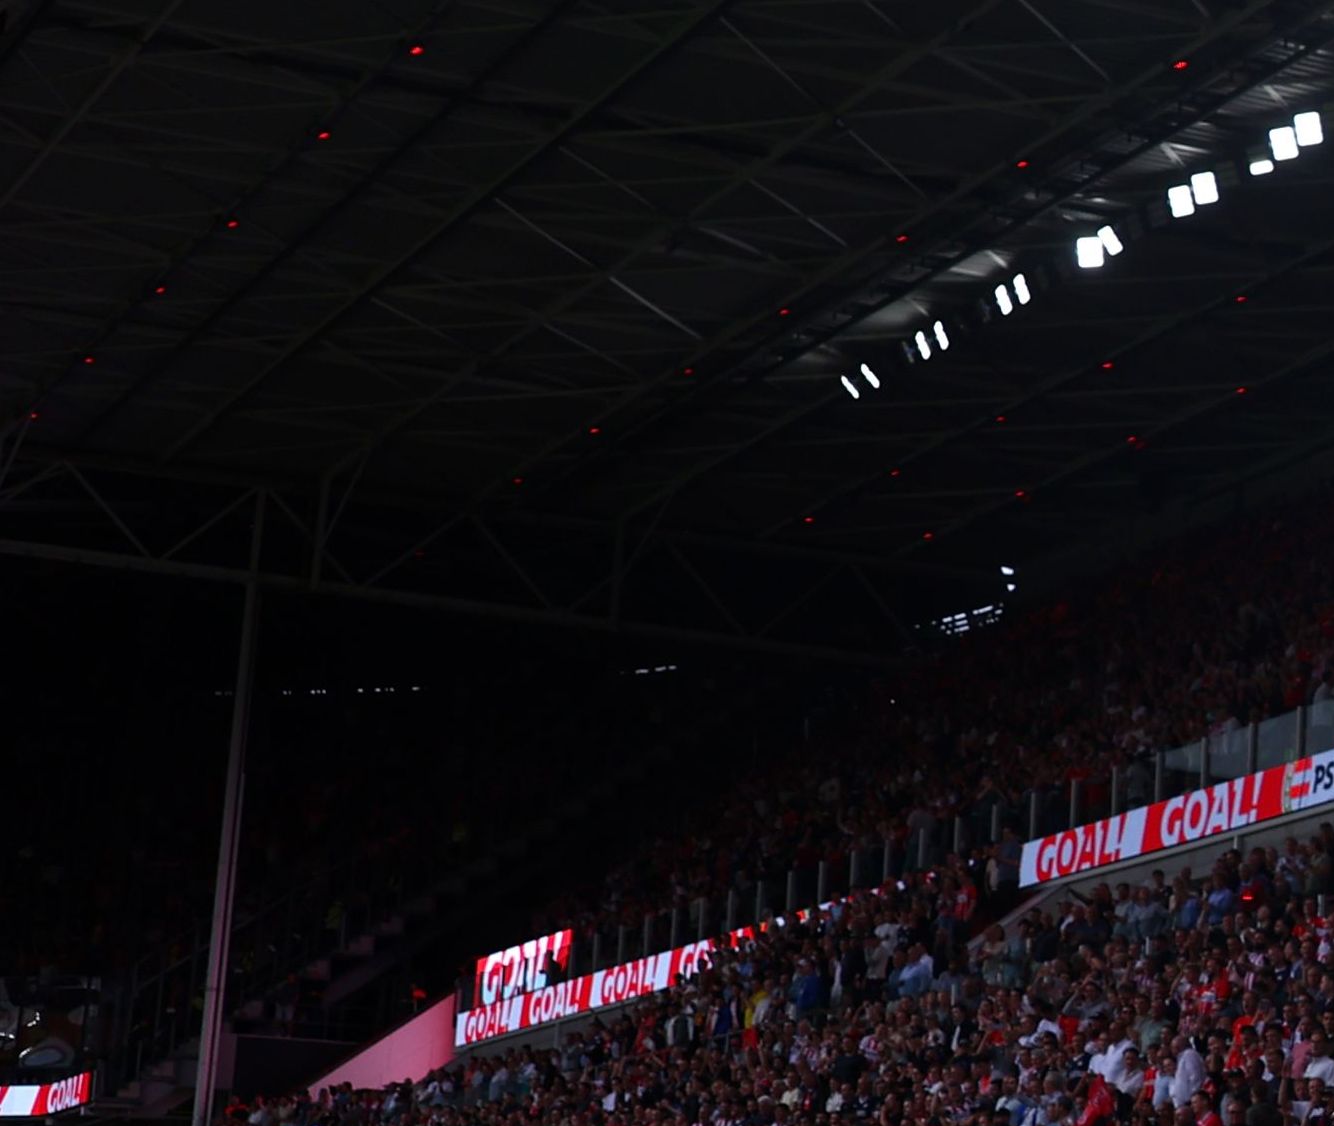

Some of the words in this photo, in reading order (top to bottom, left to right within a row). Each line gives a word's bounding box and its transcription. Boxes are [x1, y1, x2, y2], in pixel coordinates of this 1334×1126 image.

[1160, 771, 1264, 848] GOAL!
[1036, 812, 1128, 883] GOAL!
[530, 976, 584, 1025] GOAL!
[602, 952, 659, 1006] GOAL!
[465, 998, 512, 1044] GOAL!
[47, 1073, 84, 1114] GOAL!
